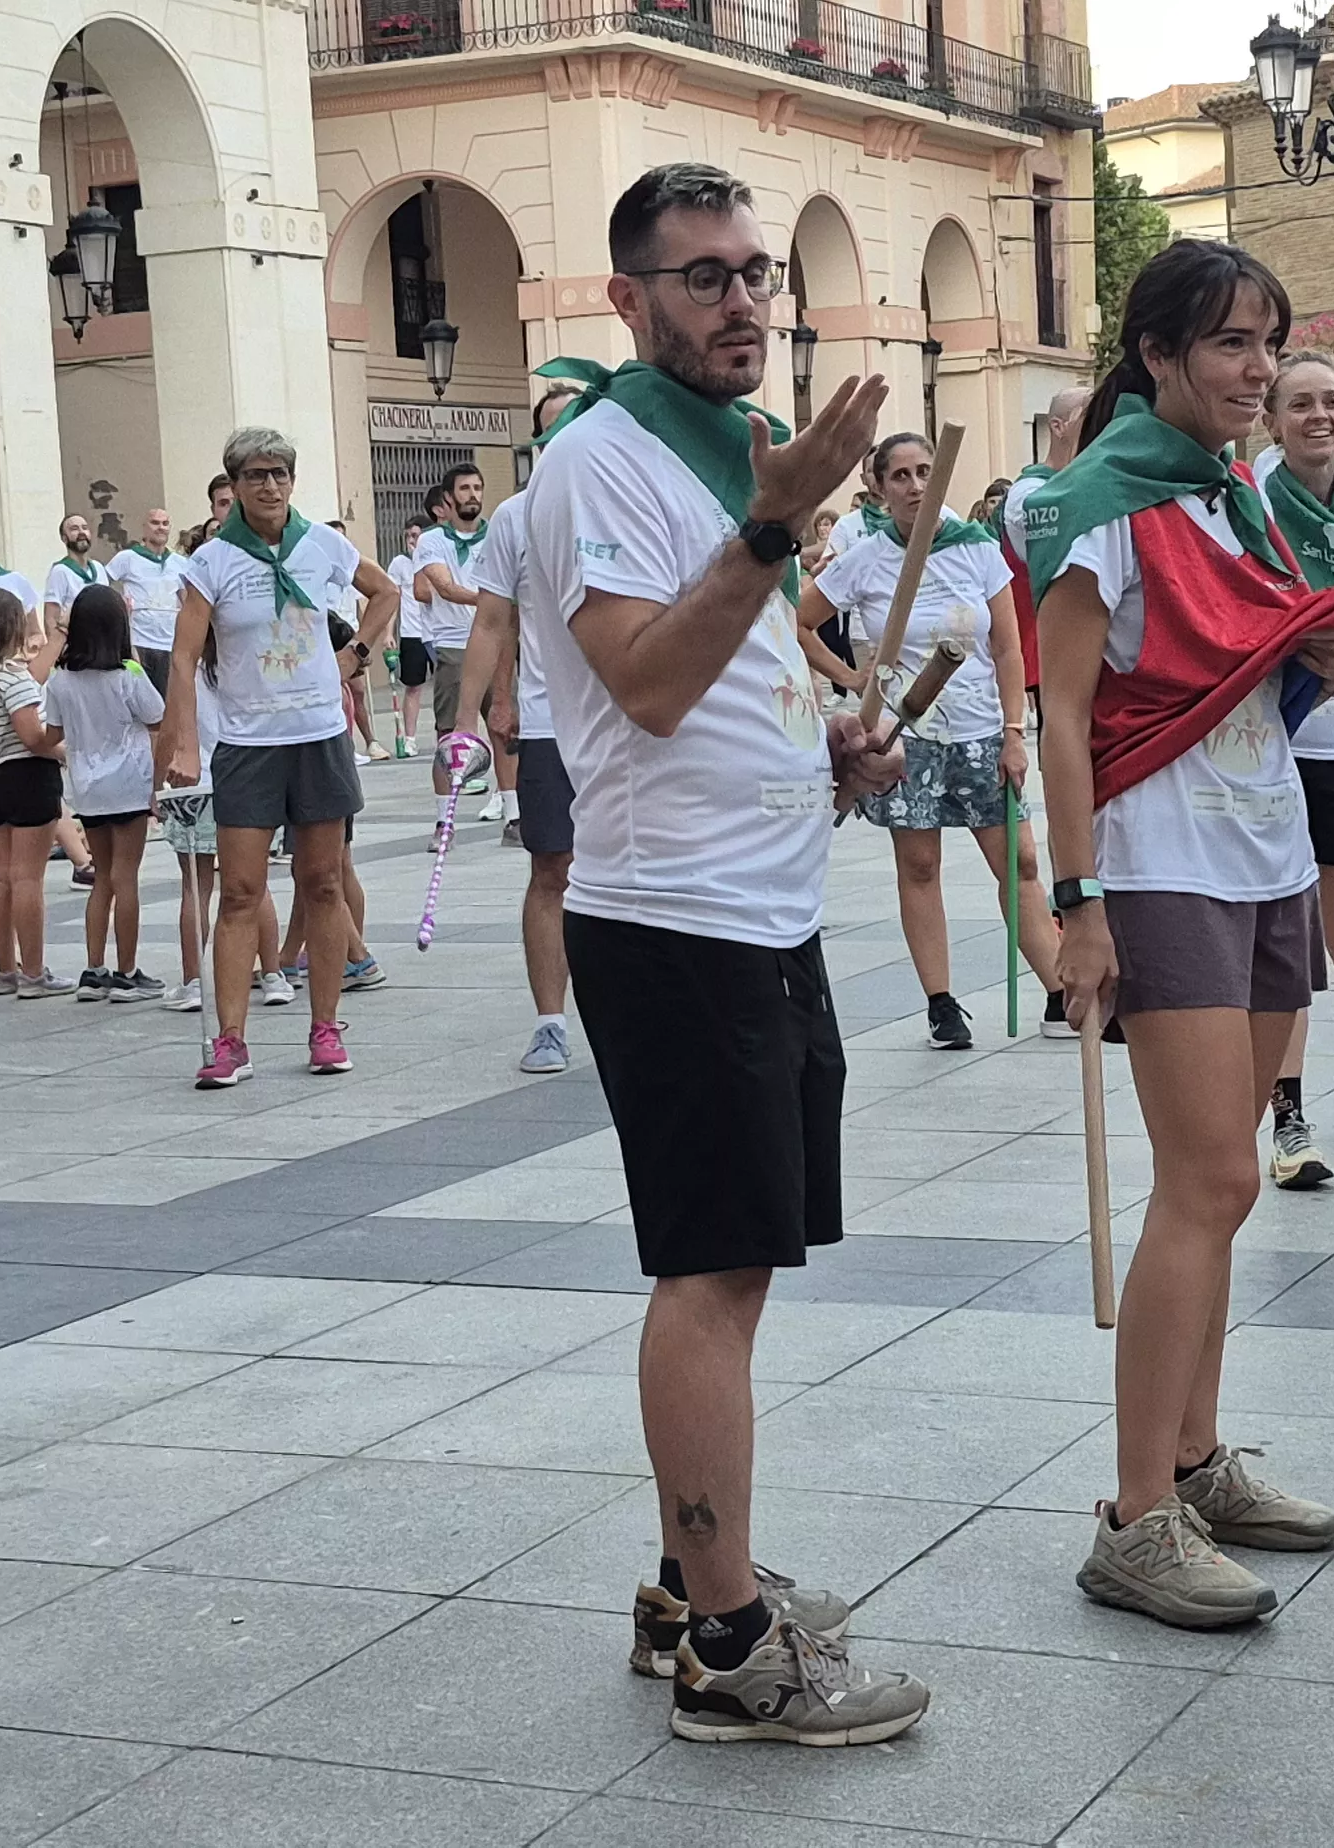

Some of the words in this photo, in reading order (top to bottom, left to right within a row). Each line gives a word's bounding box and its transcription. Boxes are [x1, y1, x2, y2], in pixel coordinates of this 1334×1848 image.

[371, 405, 433, 430] CHACINERIA
[450, 409, 486, 432] AMADO
[488, 411, 508, 433] ARA
